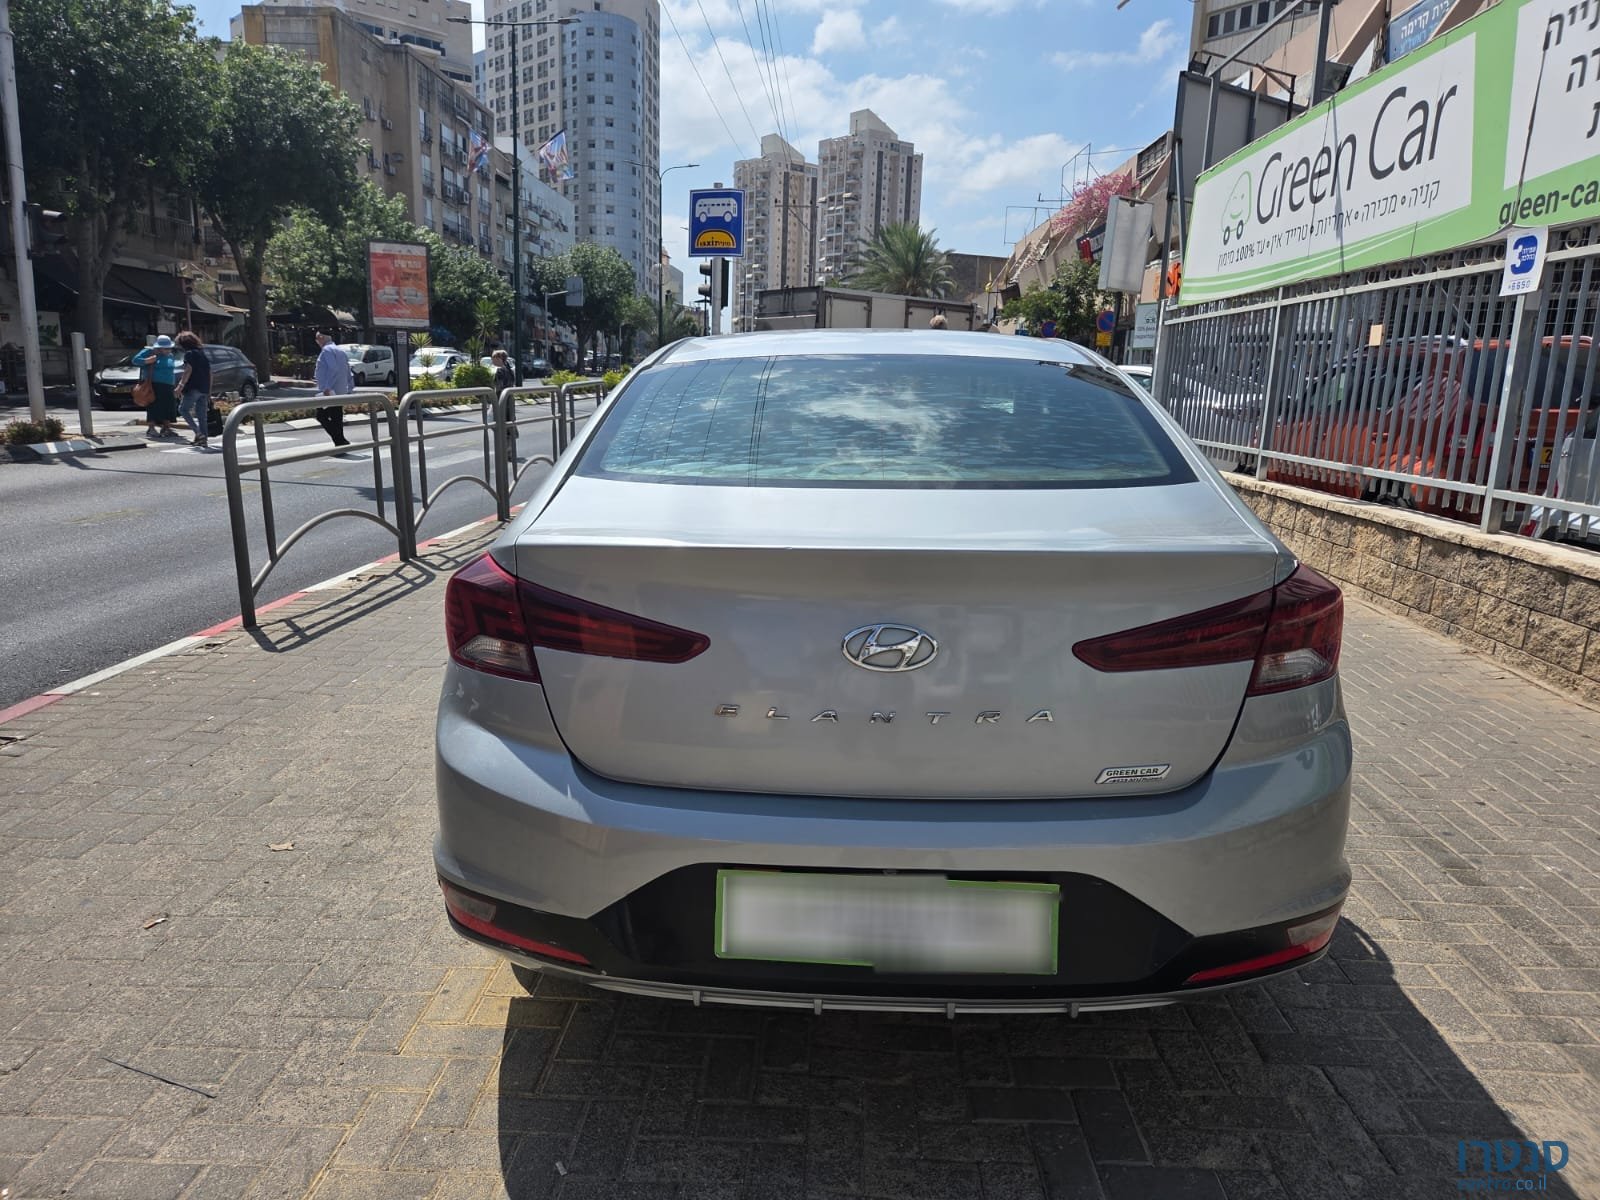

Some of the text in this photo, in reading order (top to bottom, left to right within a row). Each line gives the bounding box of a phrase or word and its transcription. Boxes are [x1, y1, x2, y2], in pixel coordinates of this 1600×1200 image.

[1401, 11, 1430, 39] קדימה
[1257, 85, 1458, 224] Green Car
[1498, 180, 1600, 230] green-ca
[1217, 180, 1441, 273] קניה מכירה אחריות טרייד אין עד 100% מימון
[714, 703, 1055, 724] ELANTRA
[1105, 767, 1159, 777] GREEN CAR
